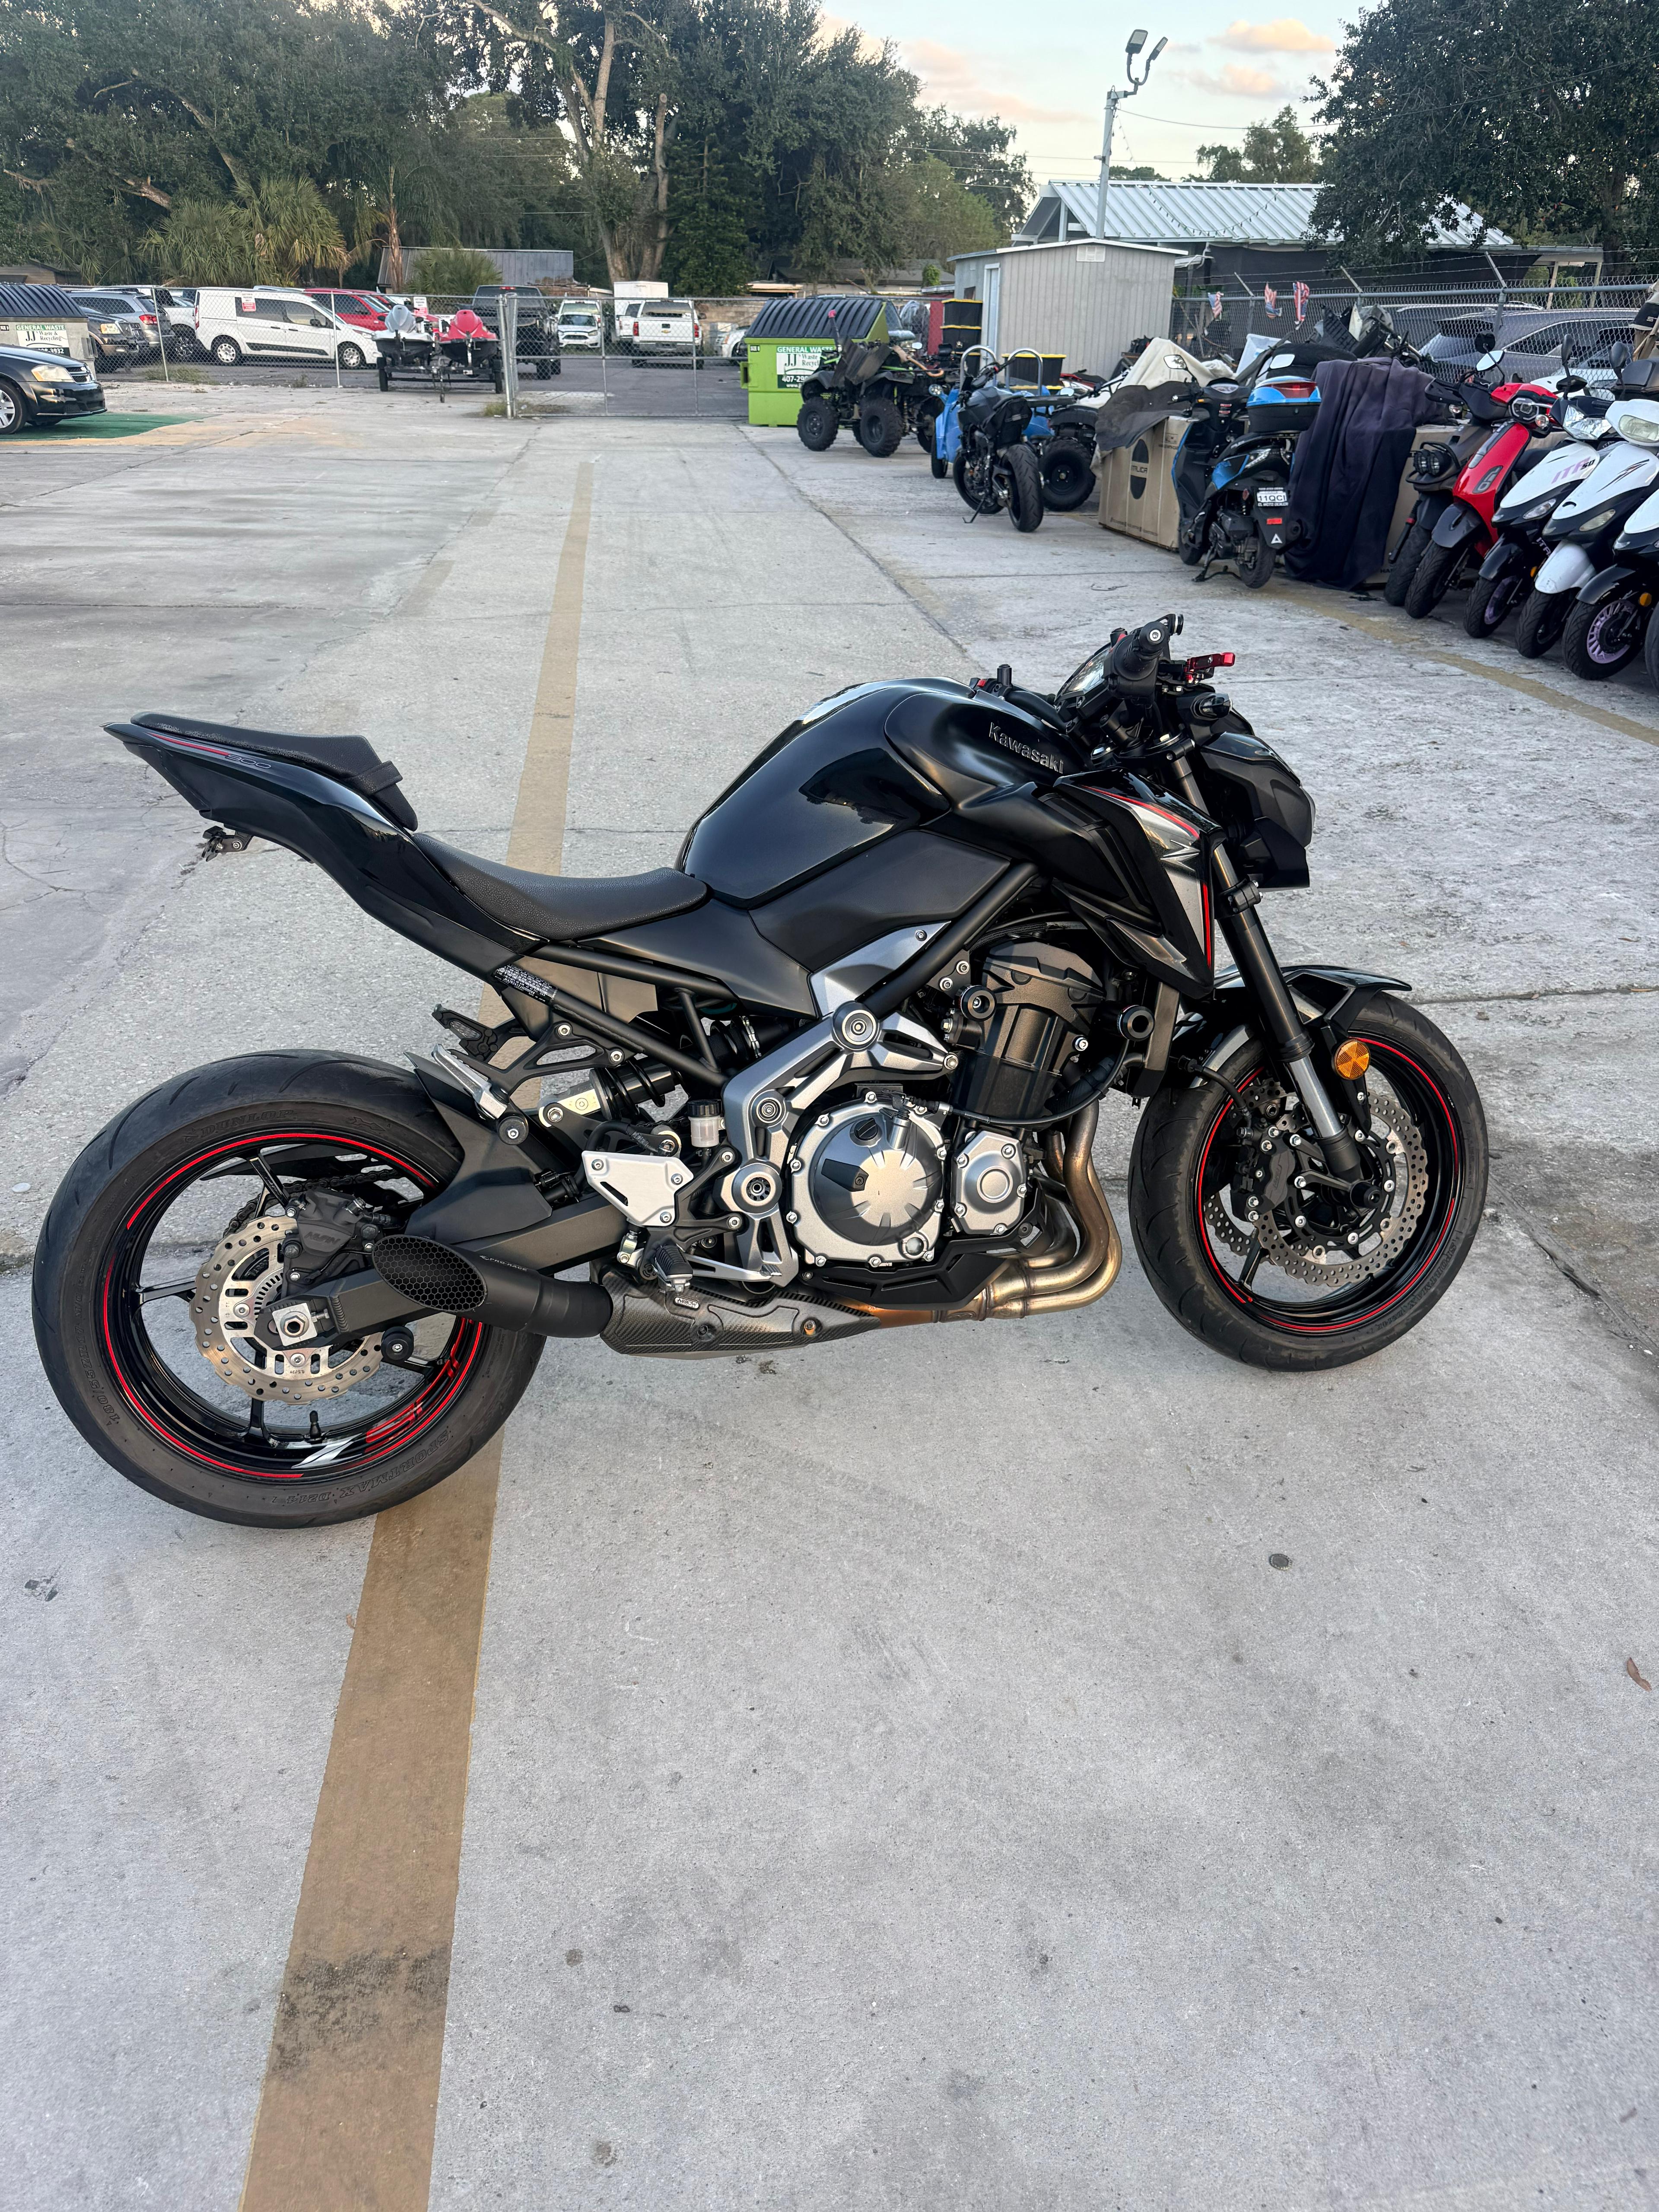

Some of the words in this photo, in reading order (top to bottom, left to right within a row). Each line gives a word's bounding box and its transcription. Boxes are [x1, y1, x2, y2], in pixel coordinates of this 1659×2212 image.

[1580, 459, 1595, 470] 50
[989, 722, 1064, 774] Kawasaki
[225, 753, 272, 769] 900
[200, 1109, 294, 1138] DUNLOP
[677, 1298, 697, 1306] ARROW
[75, 1325, 121, 1422] 180/55ZR17
[339, 1429, 451, 1499] SPORTMAX
[286, 1491, 331, 1504] D214
